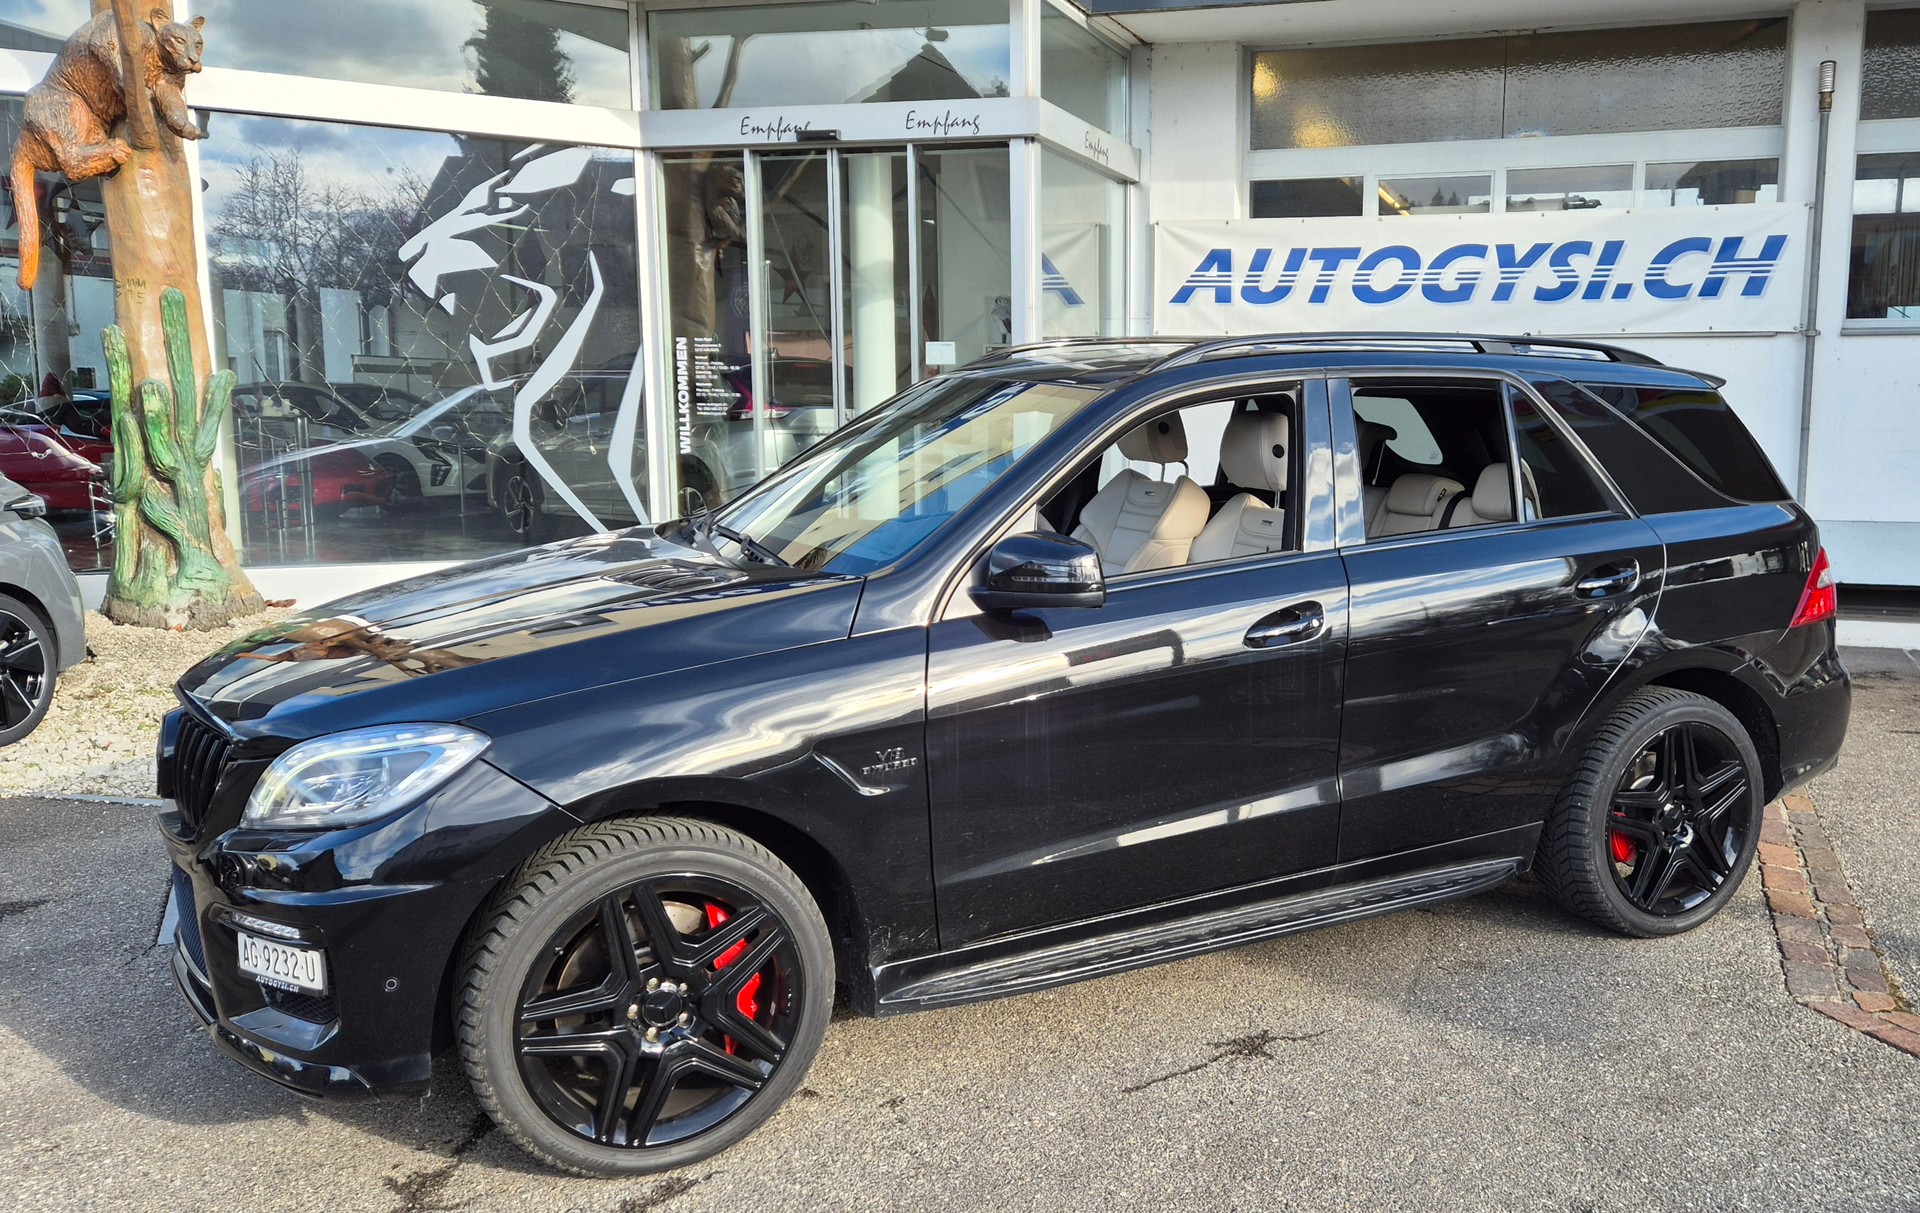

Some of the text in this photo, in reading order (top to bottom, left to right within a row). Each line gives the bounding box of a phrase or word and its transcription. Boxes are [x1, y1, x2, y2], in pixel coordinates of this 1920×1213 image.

[905, 109, 980, 136] Empfang
[1170, 233, 1788, 304] AUTOGYSI.CH
[675, 336, 692, 455] WILLKOMMEN
